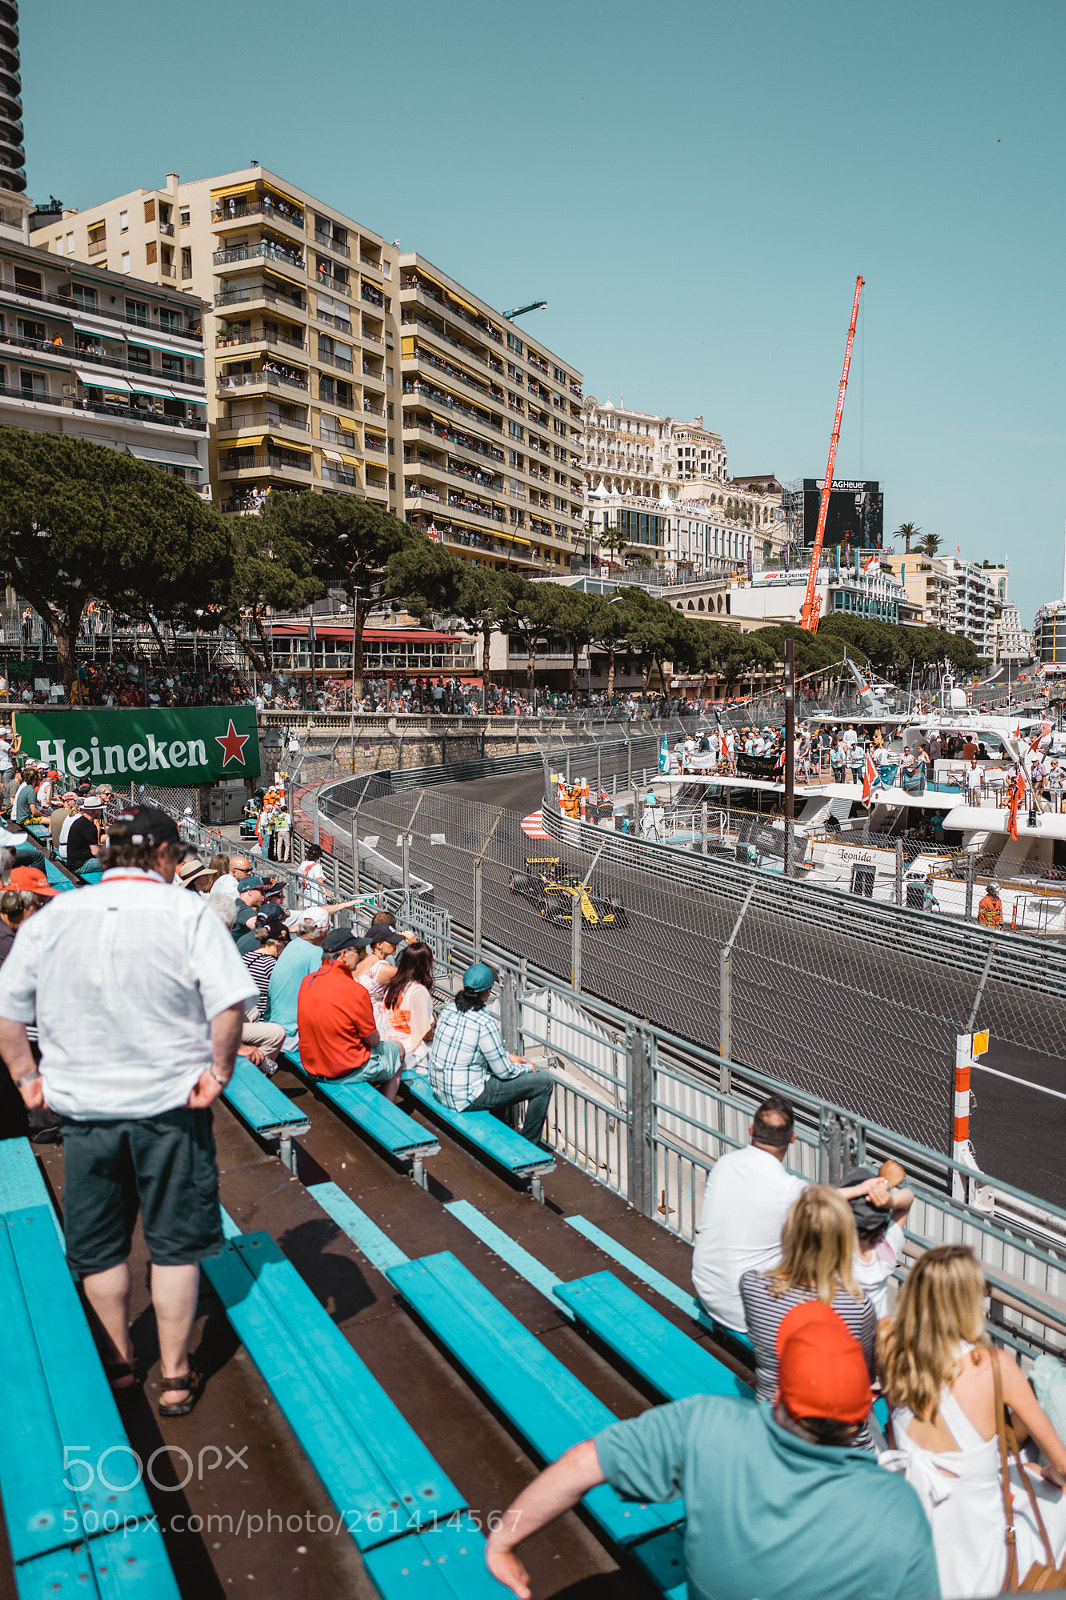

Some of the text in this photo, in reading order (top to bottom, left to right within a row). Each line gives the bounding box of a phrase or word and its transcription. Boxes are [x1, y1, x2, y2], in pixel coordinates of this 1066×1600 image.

[831, 480, 867, 490] AGHeuer
[37, 734, 209, 776] Heineken
[838, 849, 872, 863] Leonida
